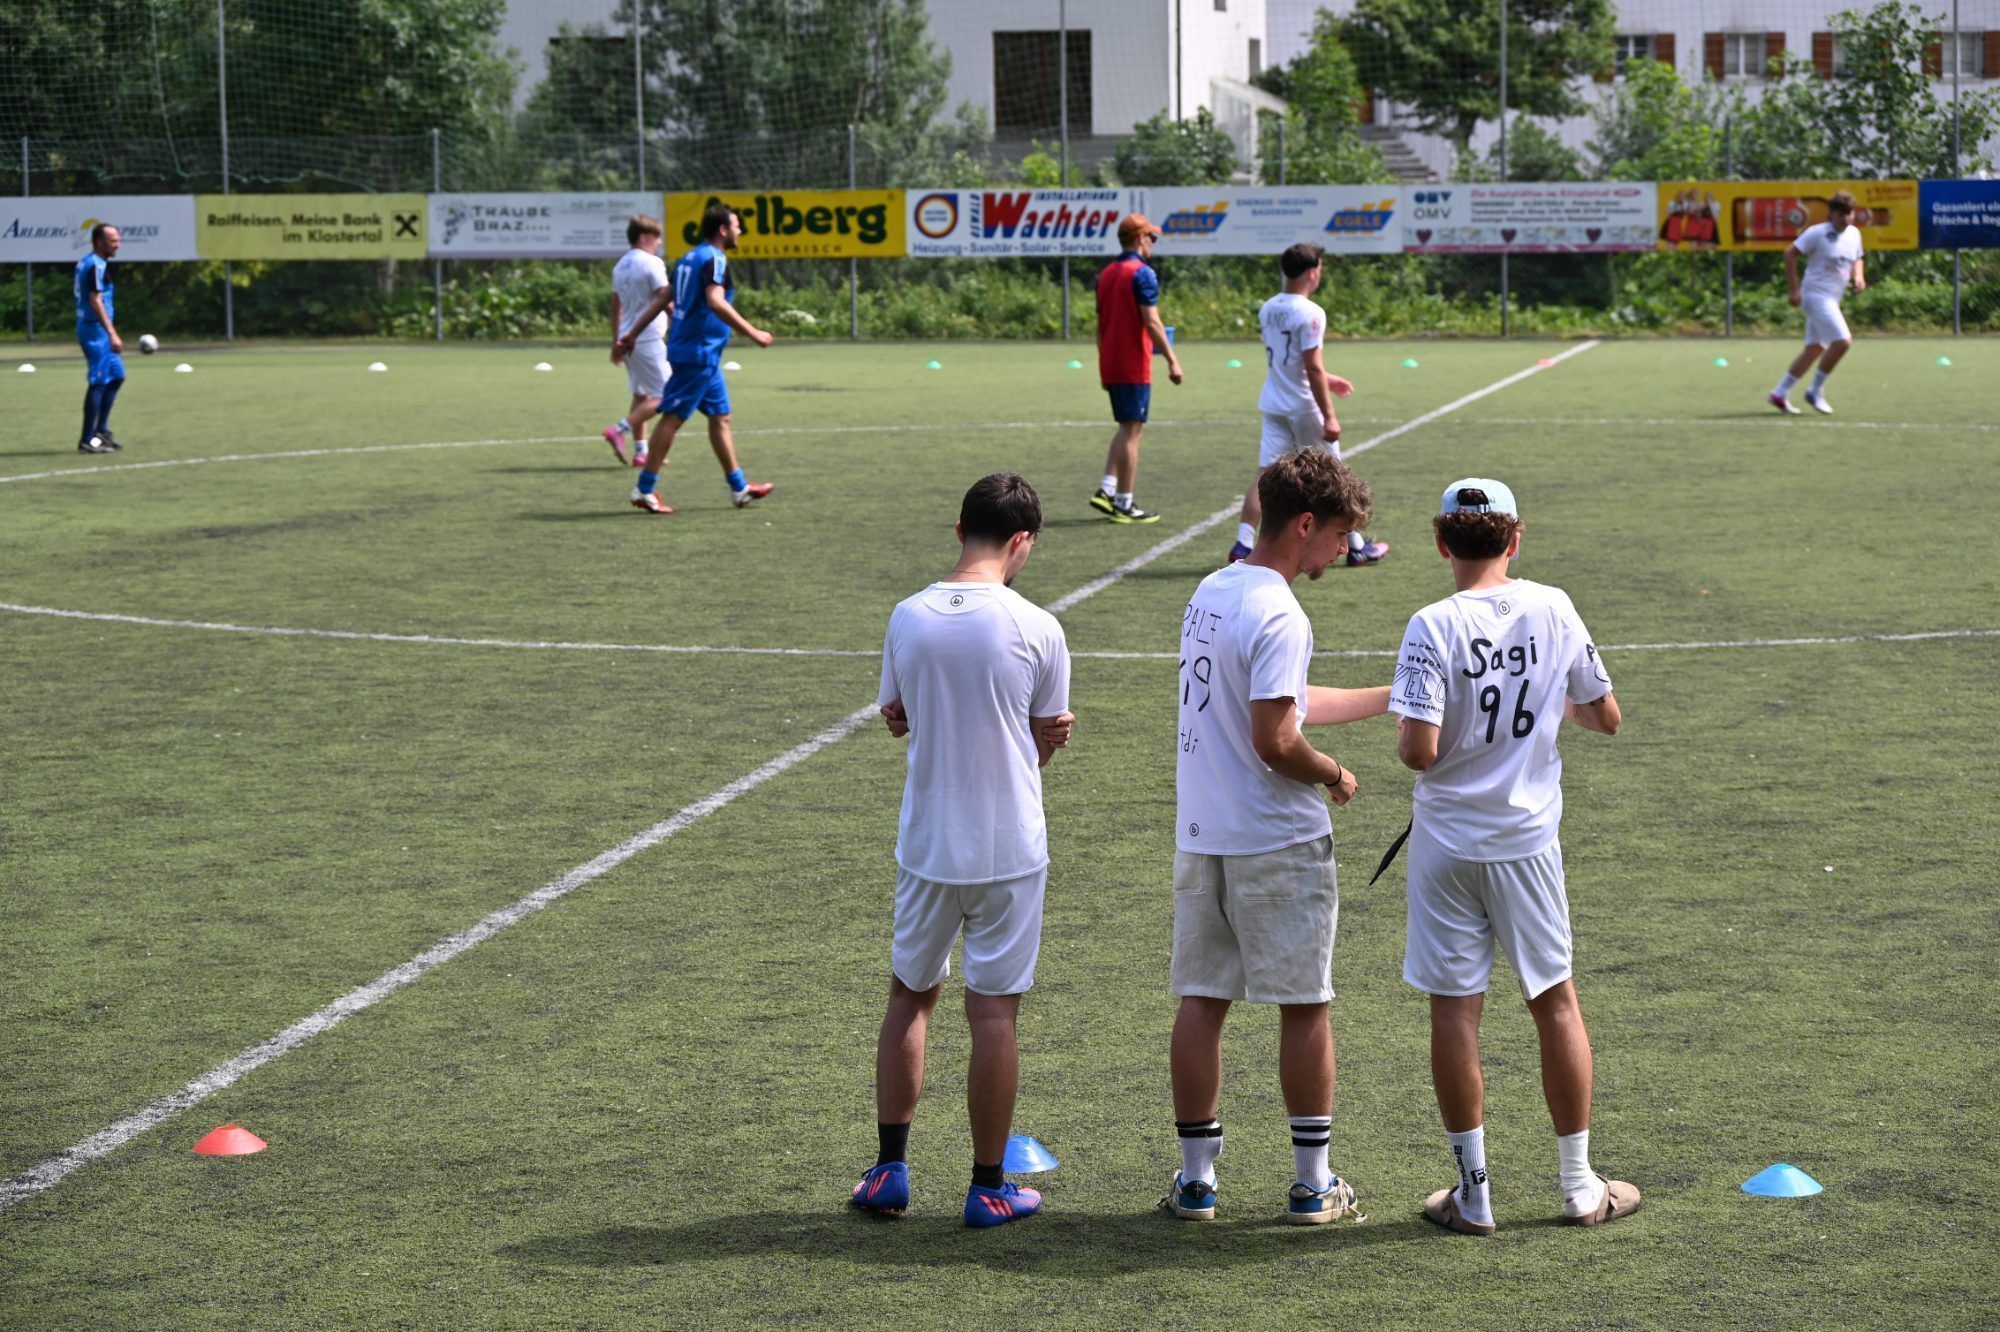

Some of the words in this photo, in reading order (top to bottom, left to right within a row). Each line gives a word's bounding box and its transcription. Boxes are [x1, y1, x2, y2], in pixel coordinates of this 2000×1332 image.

[472, 206, 550, 217] TRAUBE
[1413, 207, 1452, 219] OMV
[1932, 200, 1986, 213] Garantiert
[207, 213, 286, 226] Raiffeisen.
[291, 213, 337, 226] Meine
[343, 213, 382, 226] Bank
[983, 192, 1118, 239] Wachter
[1334, 215, 1382, 228] EGELE
[1932, 214, 1970, 226] Frische
[1972, 215, 1980, 225] &
[473, 219, 523, 231] BRAZ
[1168, 216, 1216, 229] EGELE
[117, 224, 160, 236] PRESS
[283, 229, 303, 242] im
[308, 229, 383, 242] Klostertal
[1463, 636, 1538, 678] Sagi
[1479, 678, 1536, 744] 96
